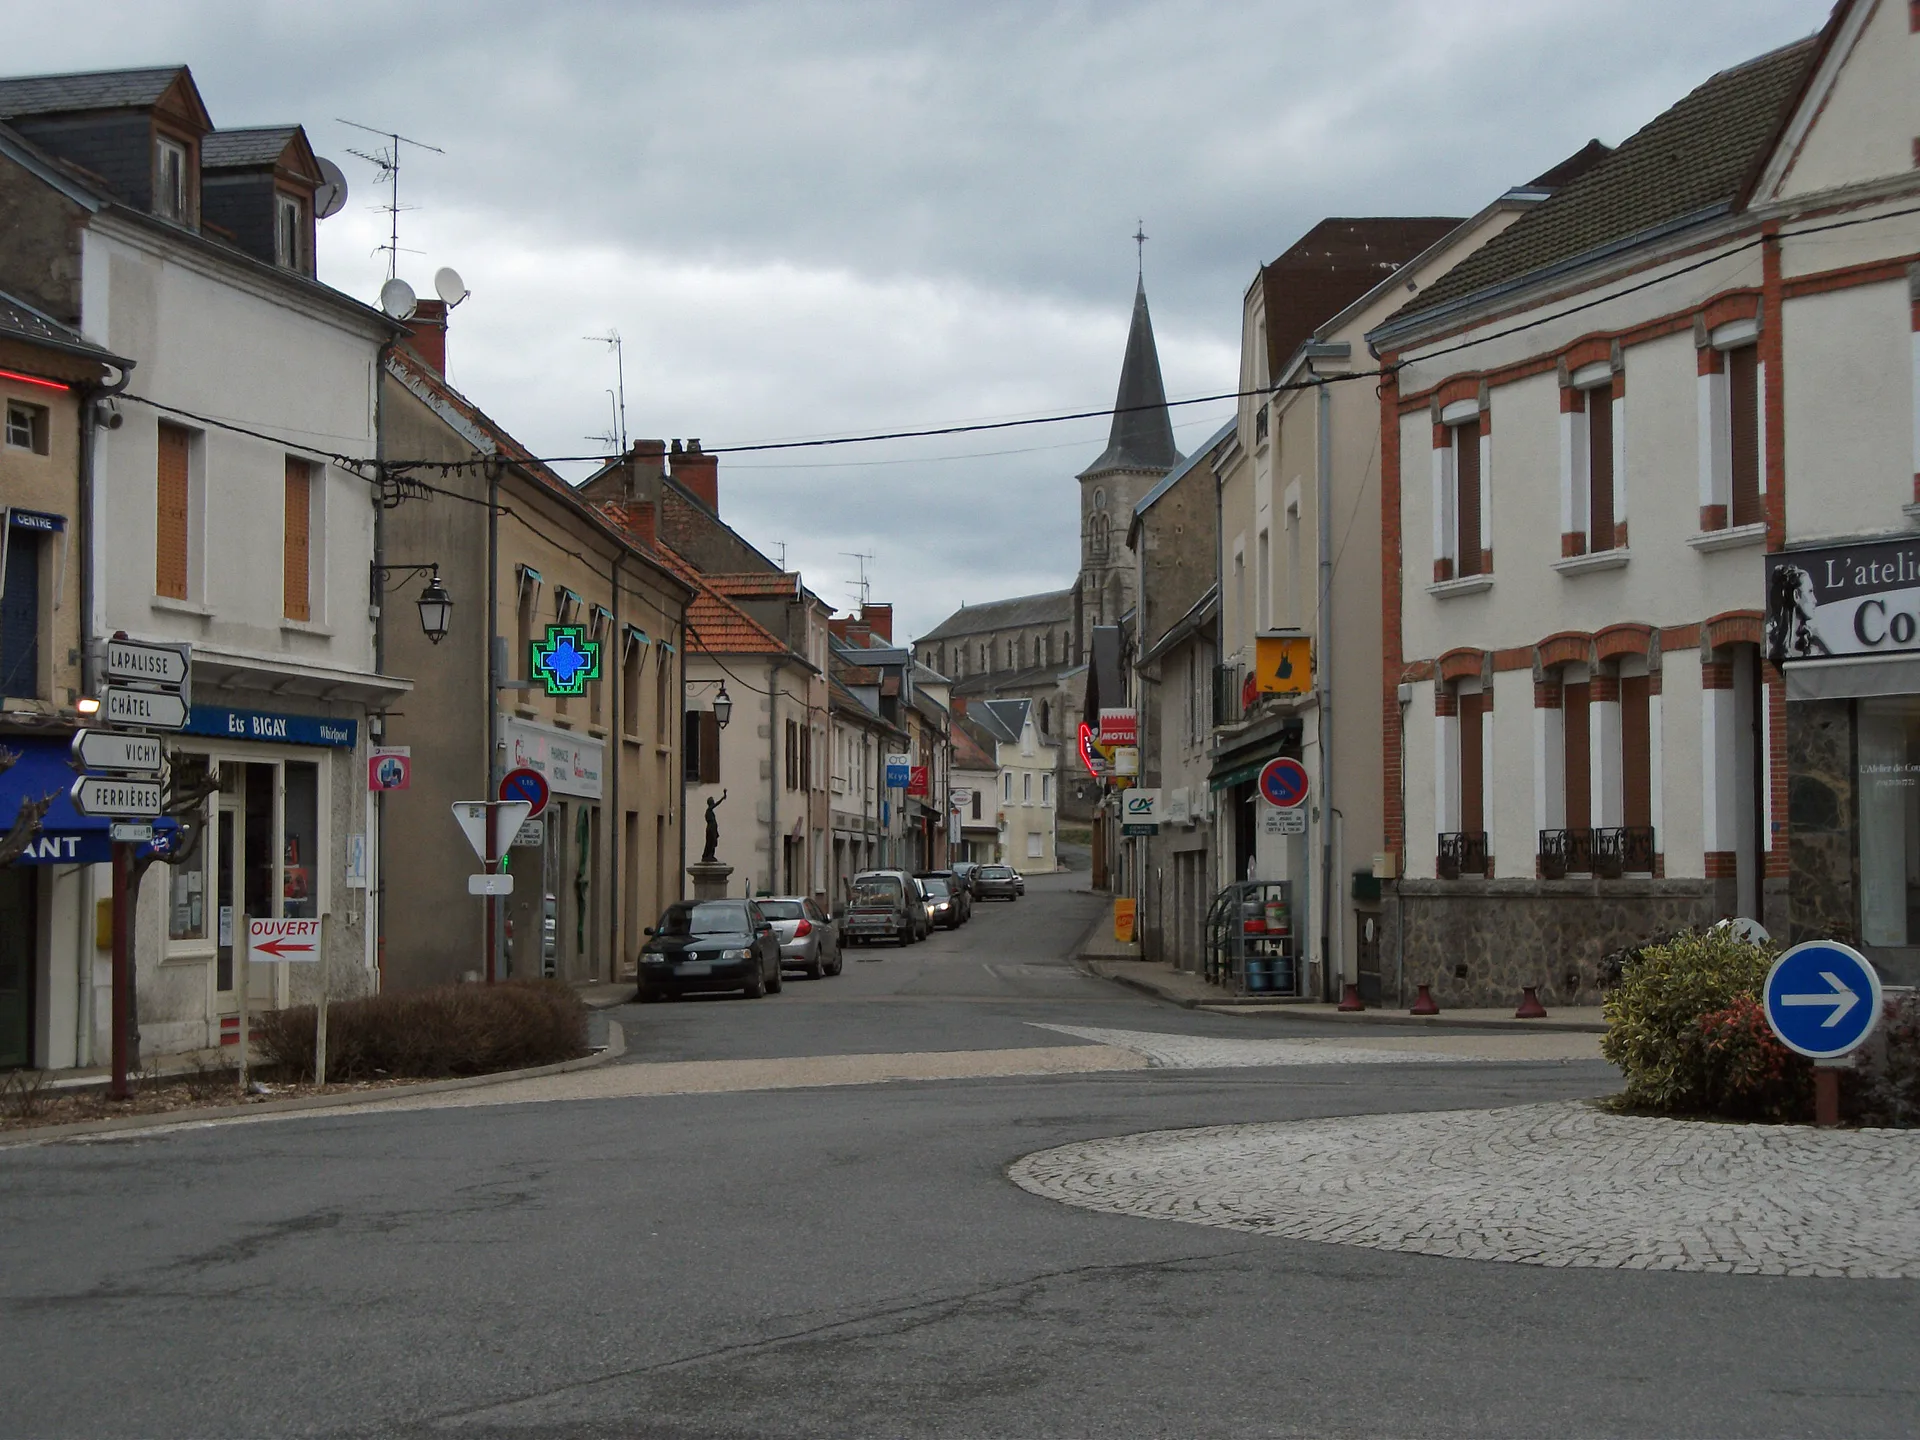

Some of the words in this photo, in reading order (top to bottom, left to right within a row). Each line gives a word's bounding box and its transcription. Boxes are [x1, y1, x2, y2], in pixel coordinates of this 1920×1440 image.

[17, 514, 53, 529] CENTRE
[1824, 551, 1920, 589] L'ateli
[111, 651, 168, 674] LAPALISSE
[111, 694, 151, 717] CHÂTEL
[228, 713, 245, 733] Ets
[252, 716, 287, 737] BIGAY
[319, 725, 349, 744] Whirlpool
[1102, 732, 1136, 741] MOTUL
[125, 743, 157, 762] VICHY
[96, 786, 158, 808] FERRIÈRES
[251, 921, 319, 936] OUVERT
